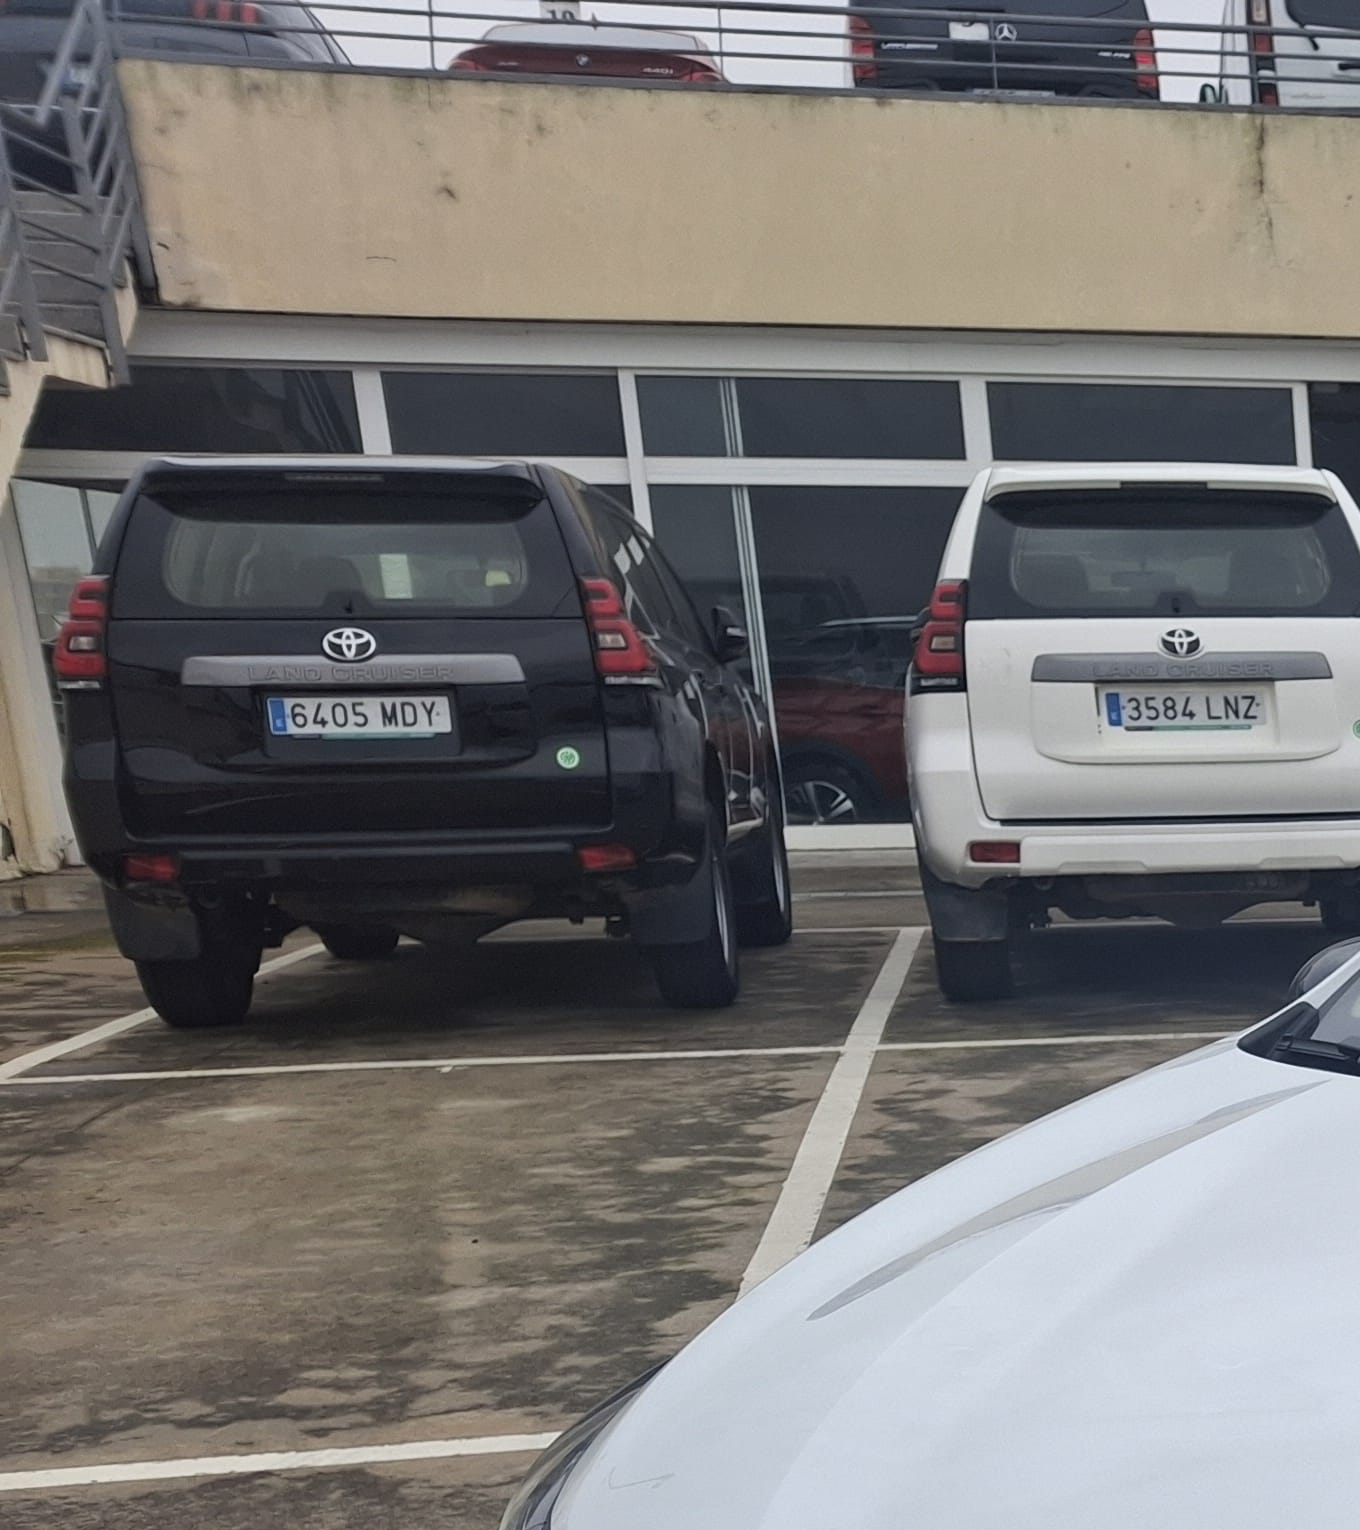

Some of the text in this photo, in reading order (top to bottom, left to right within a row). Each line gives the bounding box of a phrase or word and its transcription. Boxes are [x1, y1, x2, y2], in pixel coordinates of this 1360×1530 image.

[249, 664, 454, 682] LAND CRUISER
[1092, 662, 1274, 677] LAND CRUISER
[290, 701, 369, 729] 6405
[379, 701, 437, 728] MDY
[1126, 695, 1258, 721] 3584 LNZ
